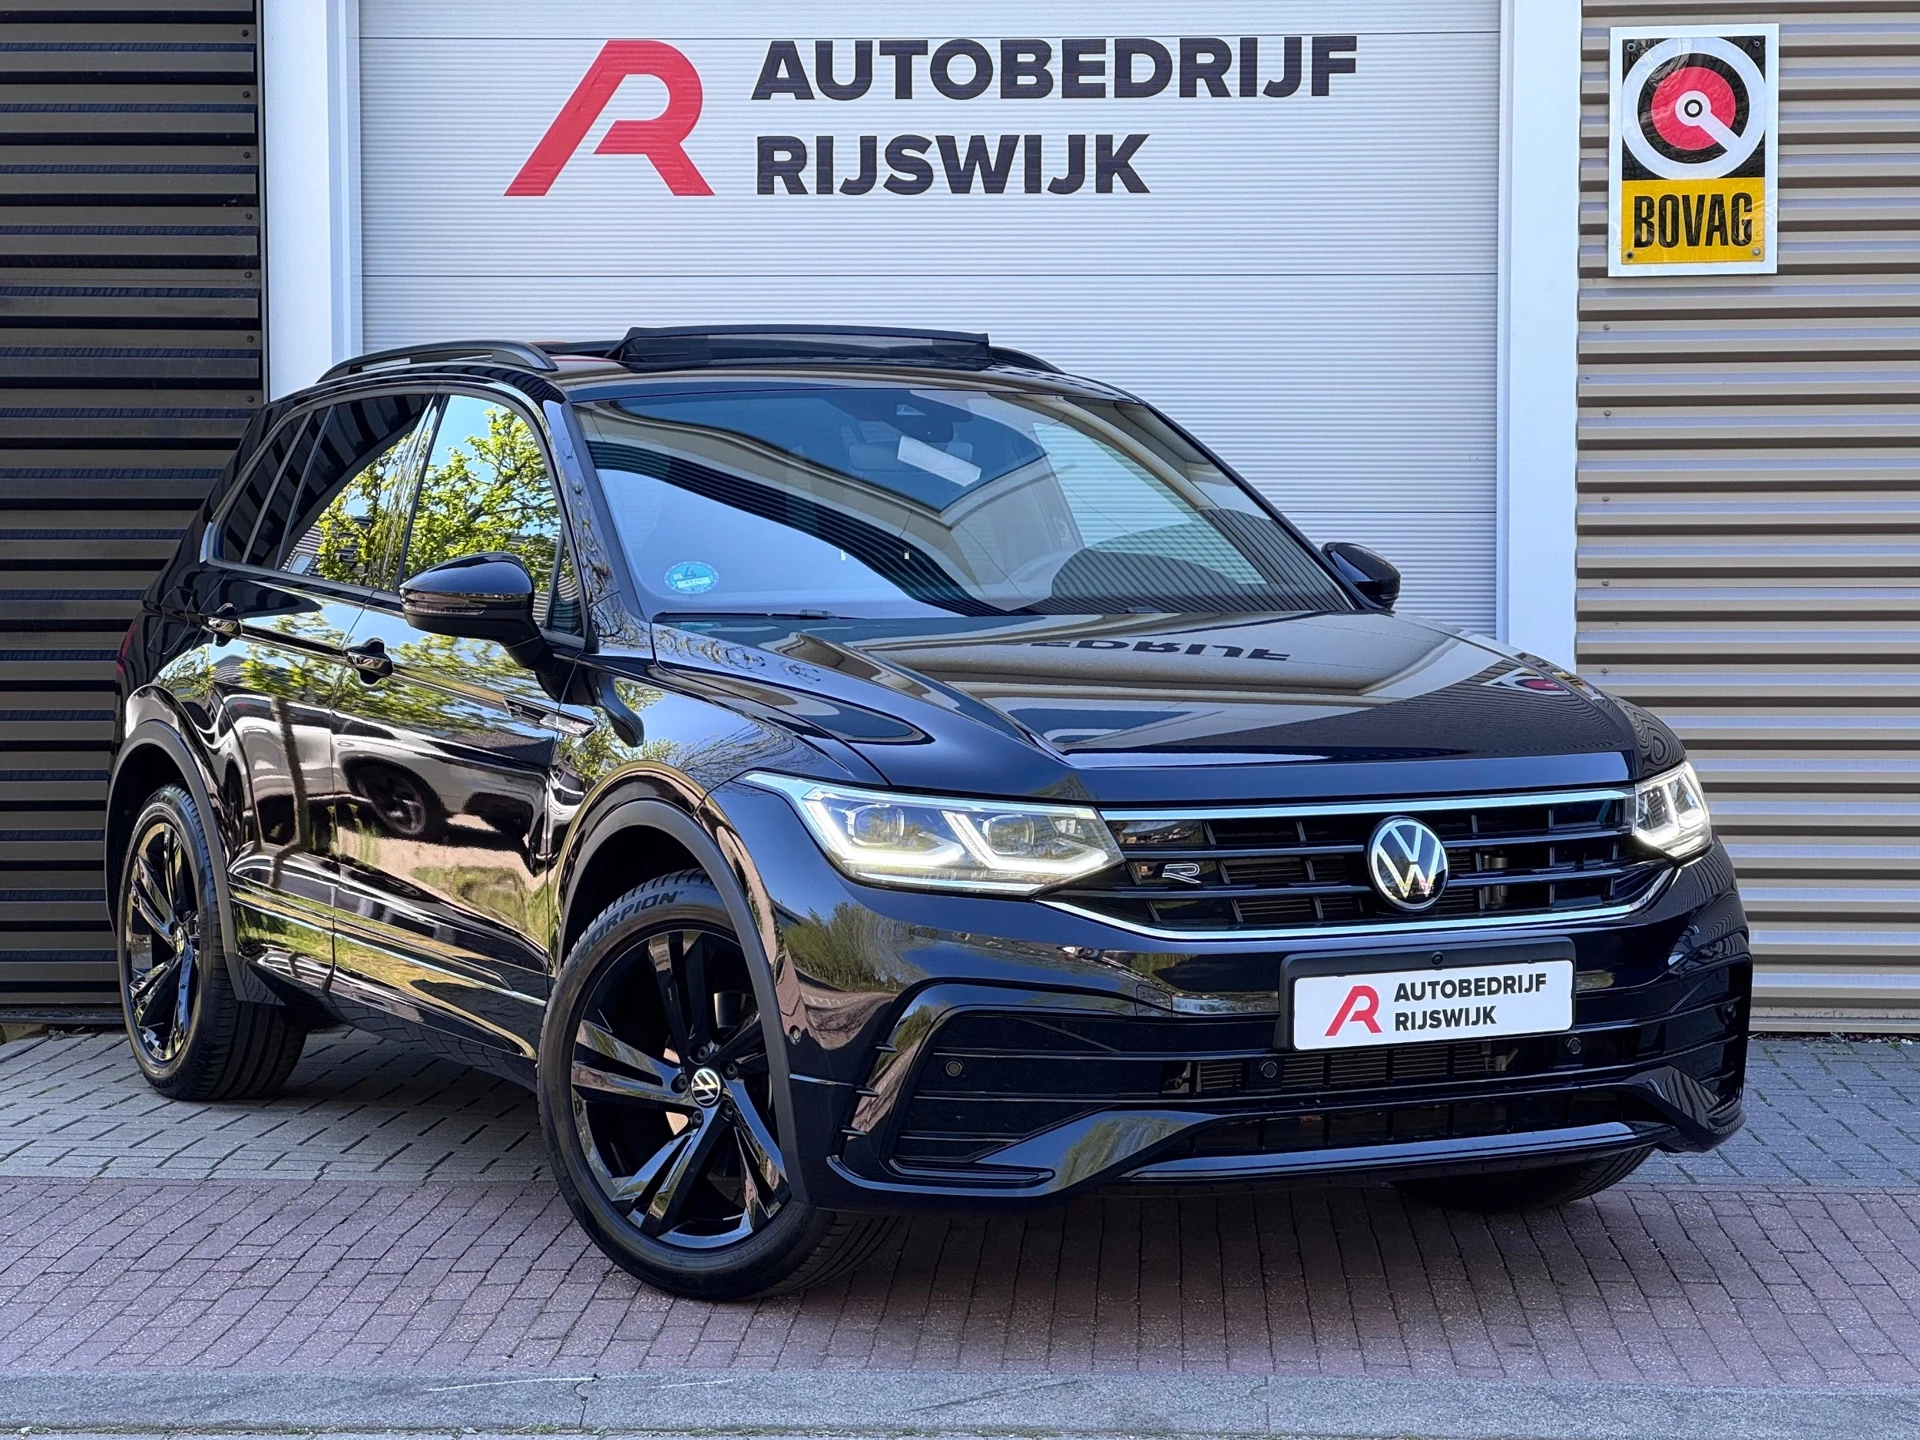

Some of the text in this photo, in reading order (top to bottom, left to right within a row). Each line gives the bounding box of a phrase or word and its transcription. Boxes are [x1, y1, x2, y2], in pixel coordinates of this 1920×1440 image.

[751, 34, 1358, 101] AUTOBEDRIJF
[757, 133, 1151, 196] RIJSWIJK
[1633, 192, 1753, 248] BOVAG
[569, 890, 681, 973] SCORPION
[1394, 973, 1547, 1002] AUTOBEDRIJF
[1395, 1006, 1496, 1032] RIJSWIJK
